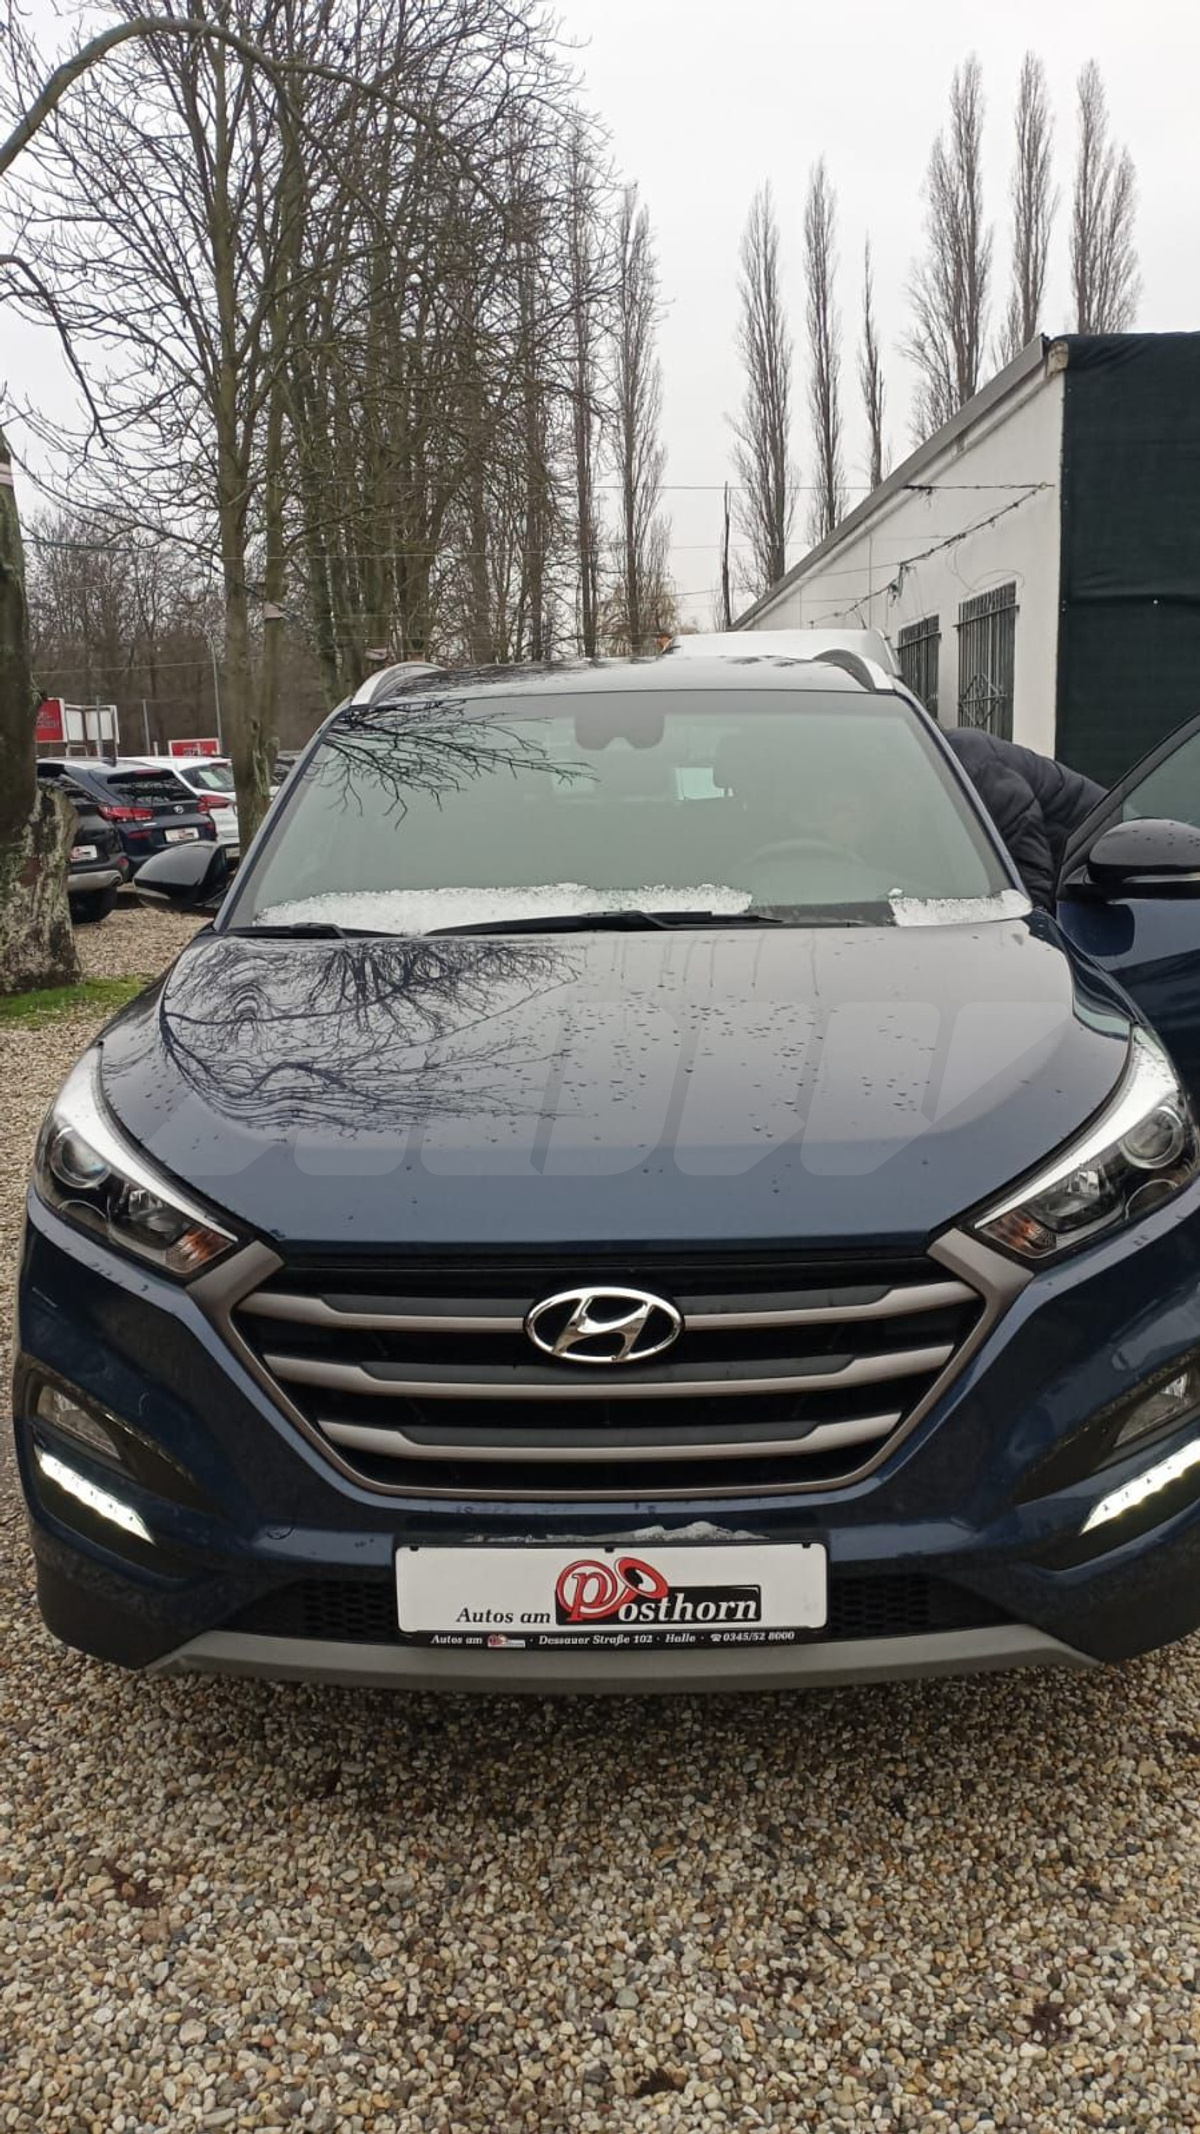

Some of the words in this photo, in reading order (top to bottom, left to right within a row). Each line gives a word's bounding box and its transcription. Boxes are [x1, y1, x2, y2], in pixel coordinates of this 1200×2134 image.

[455, 1607, 514, 1624] Autos
[520, 1612, 551, 1624] am
[430, 1634, 463, 1645] Autos
[465, 1636, 483, 1645] am
[538, 1635, 590, 1645] Dessauer
[592, 1634, 630, 1647] Straße
[633, 1634, 653, 1644] 102
[665, 1633, 697, 1643] Halle
